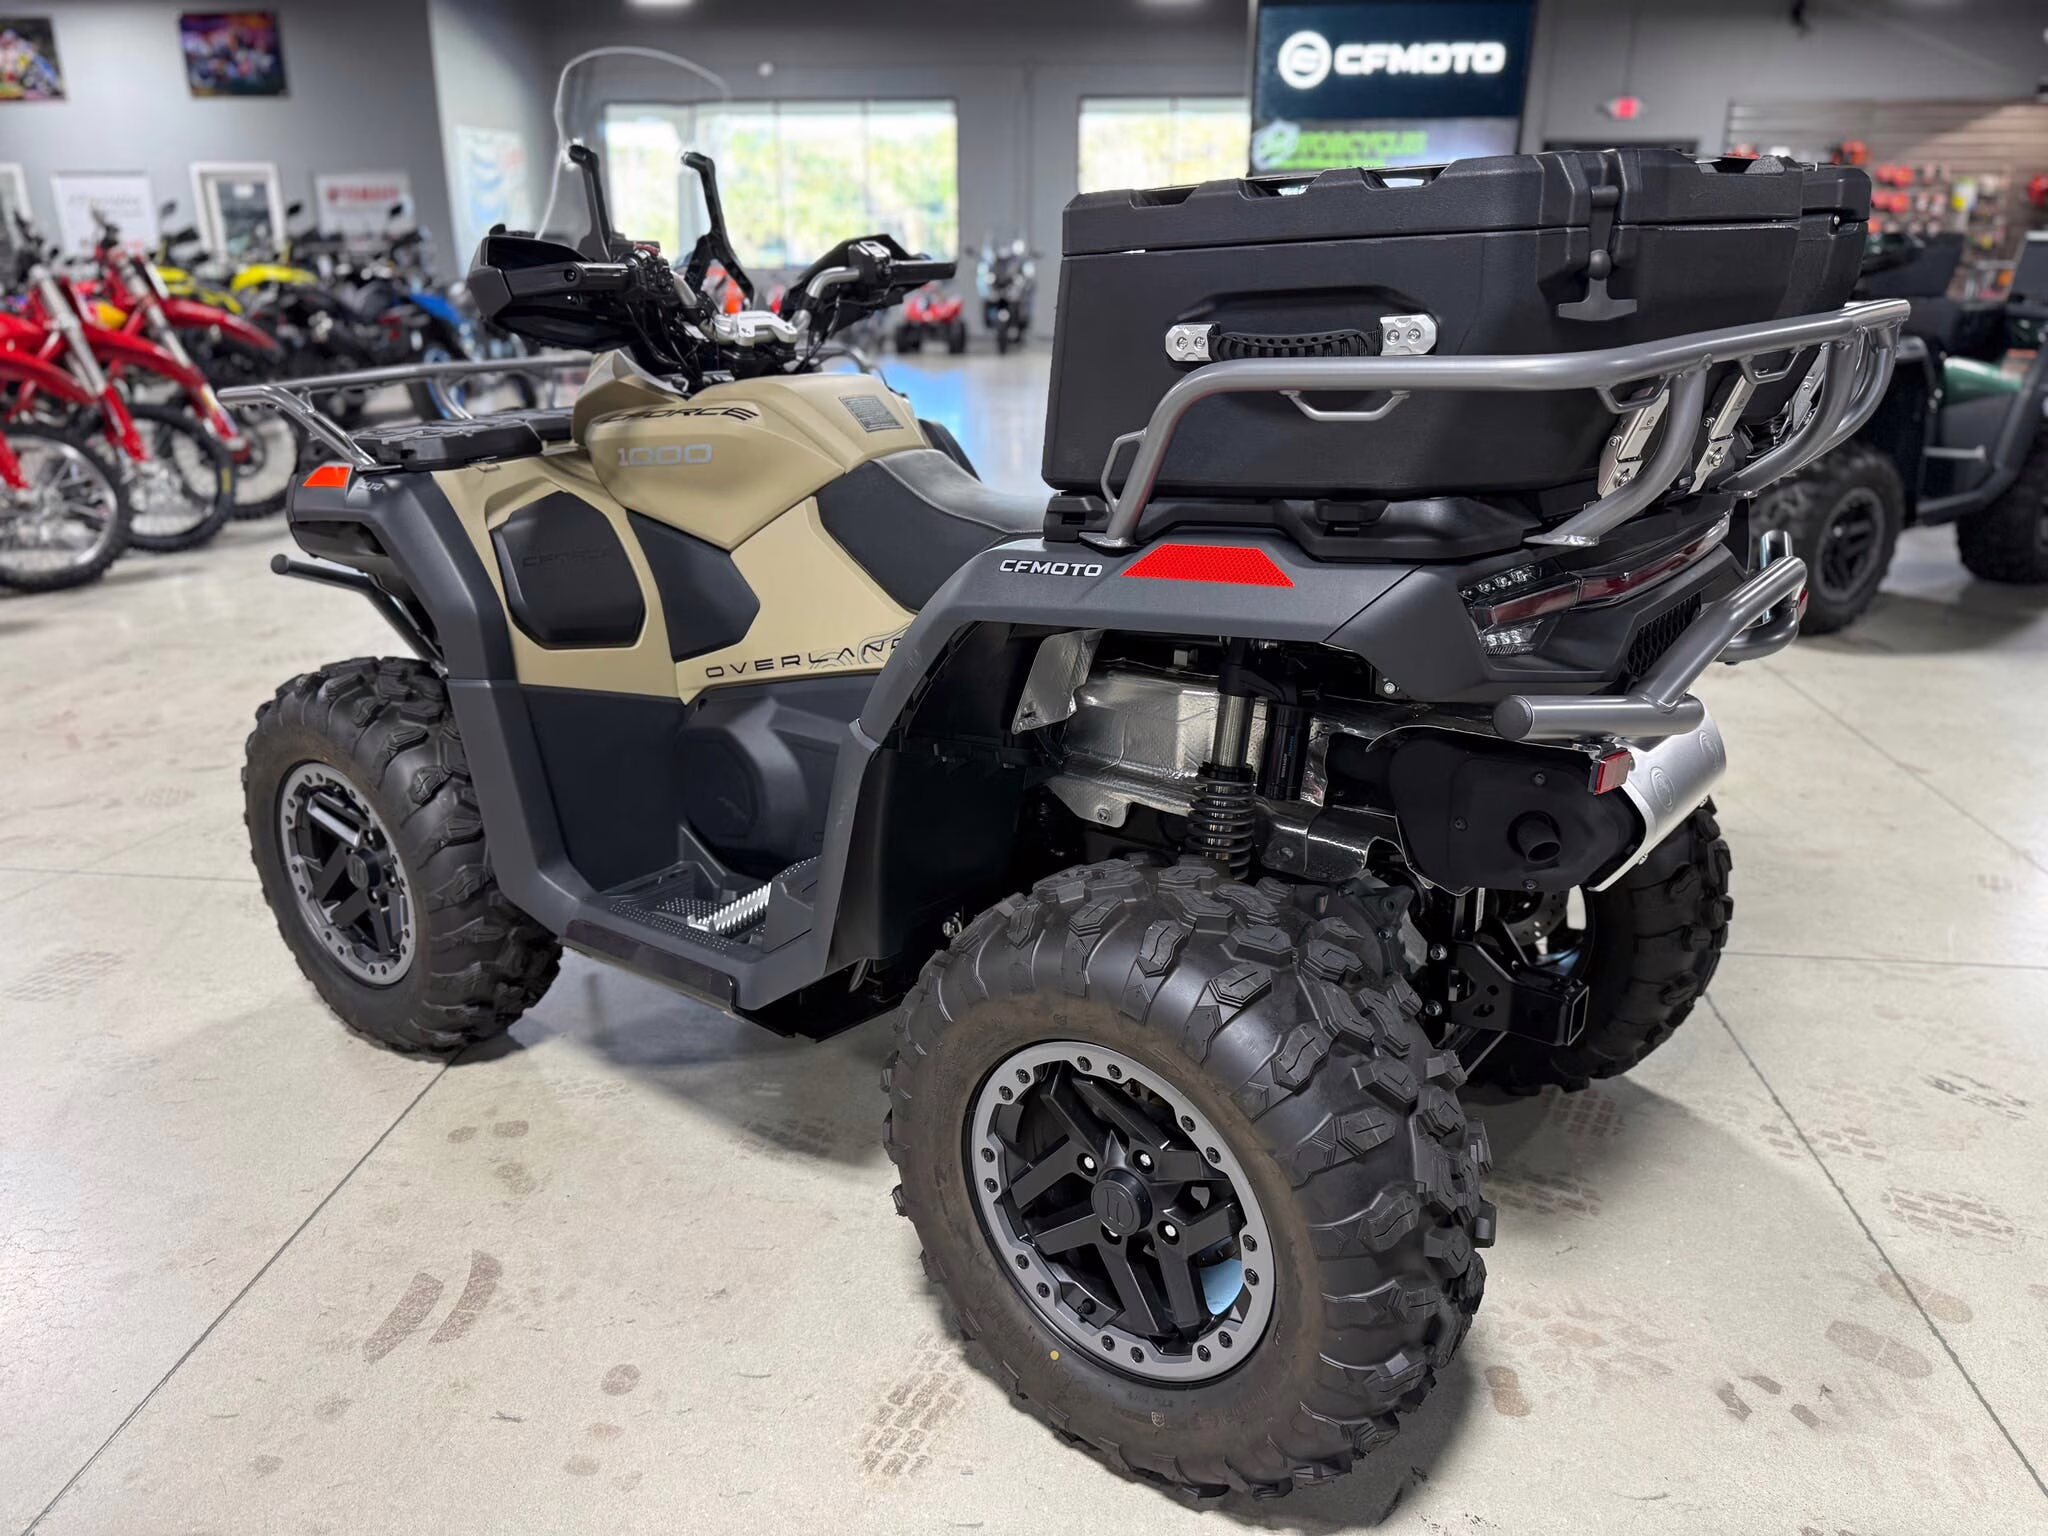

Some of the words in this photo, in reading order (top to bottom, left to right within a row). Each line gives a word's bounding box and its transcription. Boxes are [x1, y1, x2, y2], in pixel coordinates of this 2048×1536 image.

[1334, 41, 1506, 76] CFMOTO
[616, 443, 713, 467] 1000
[999, 559, 1103, 577] CFMOTO
